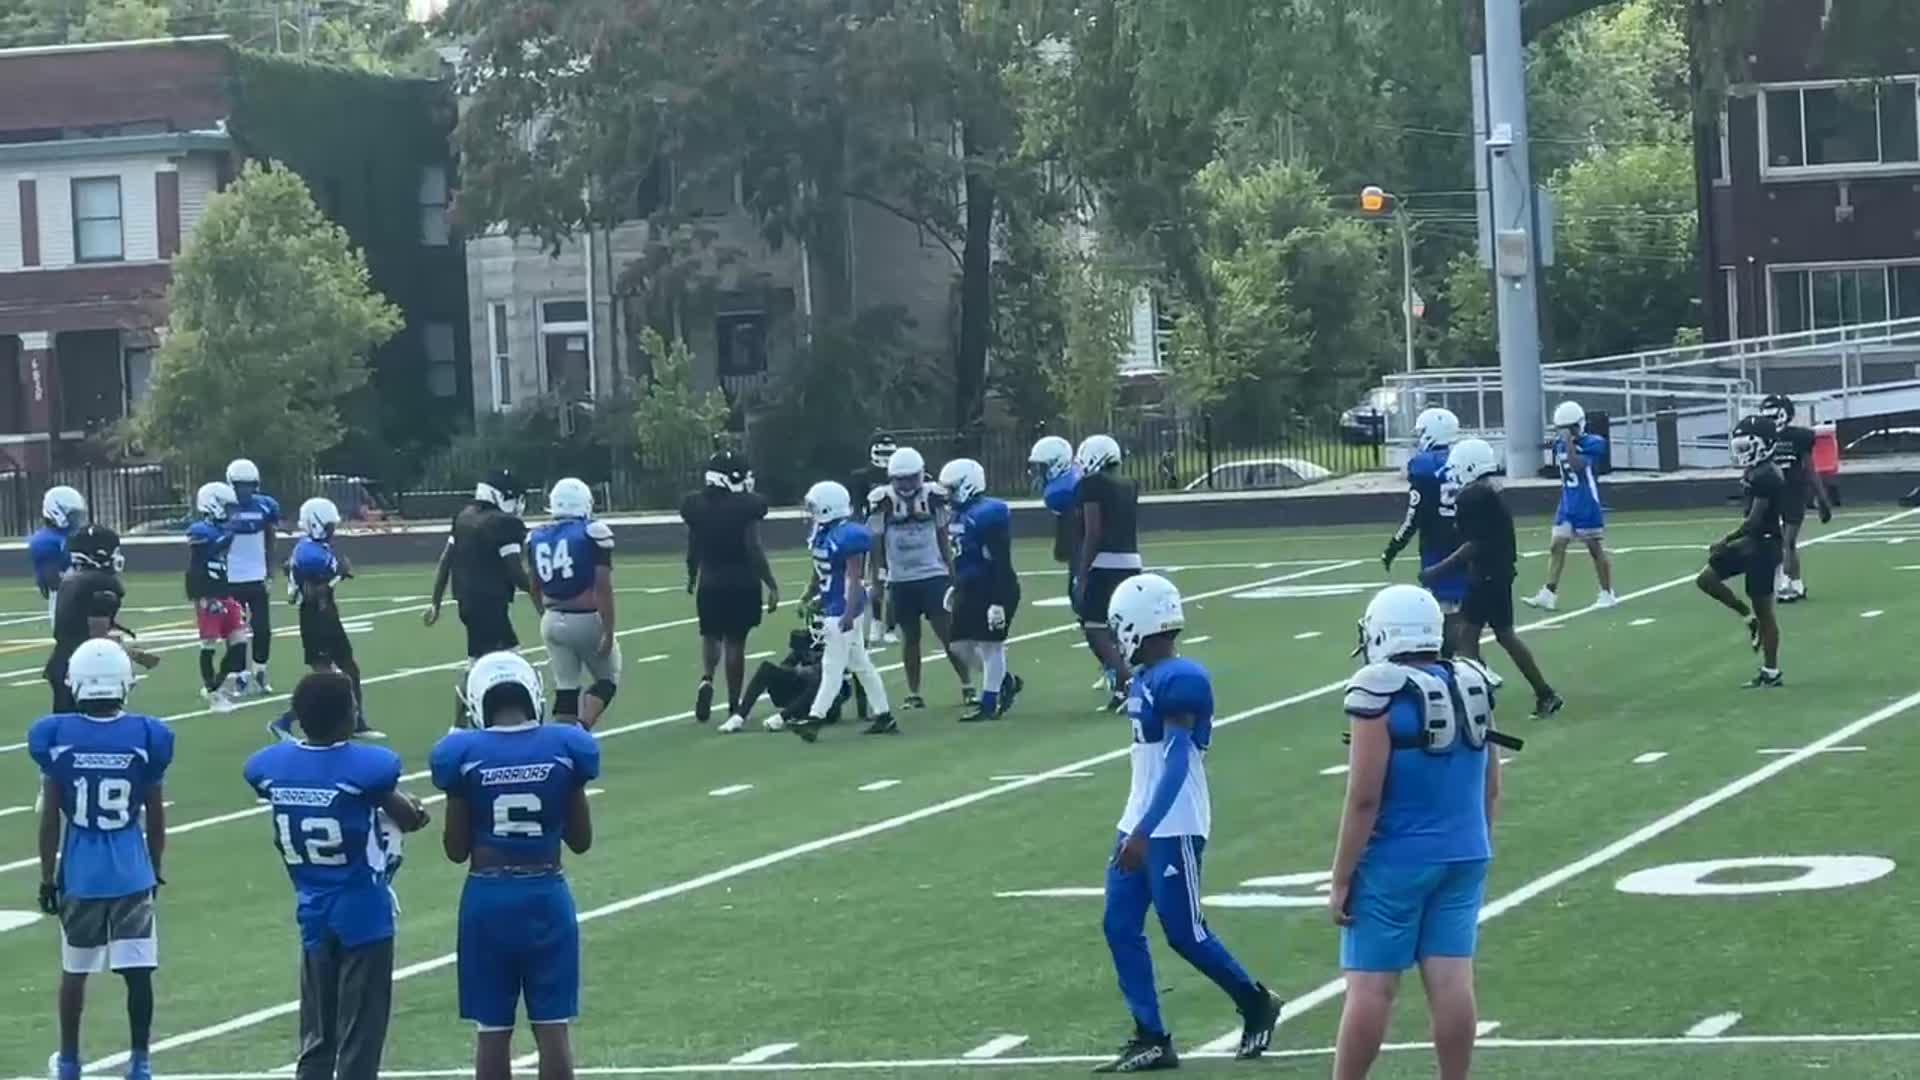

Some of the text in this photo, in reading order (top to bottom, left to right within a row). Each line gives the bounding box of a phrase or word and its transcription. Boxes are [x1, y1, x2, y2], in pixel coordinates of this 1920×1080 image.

[535, 538, 574, 583] 64
[73, 753, 135, 769] WARRIORS
[480, 764, 555, 786] WARRIORS
[72, 776, 132, 830] 19
[270, 787, 338, 808] WARRIORS
[276, 813, 348, 865] 12
